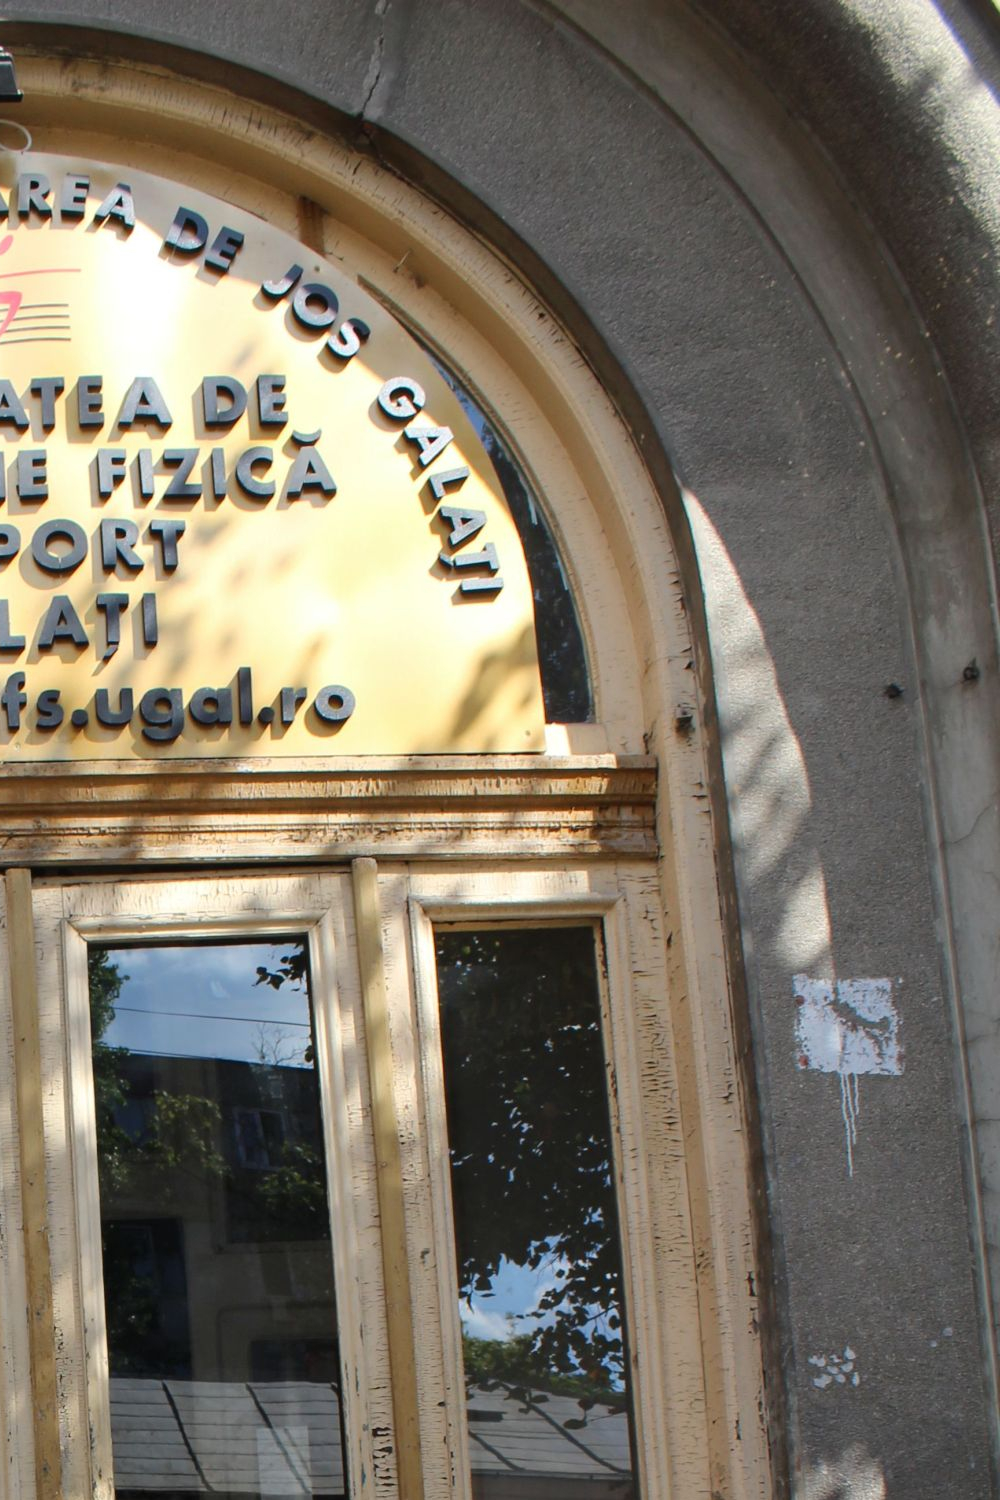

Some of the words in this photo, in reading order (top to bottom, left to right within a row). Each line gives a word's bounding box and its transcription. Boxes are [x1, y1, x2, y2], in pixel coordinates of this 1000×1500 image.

[164, 206, 244, 273] DE
[261, 263, 371, 361] JOS
[376, 376, 504, 597] GALAȚI
[201, 374, 289, 431] DE
[97, 428, 338, 500] FIZICĂ
